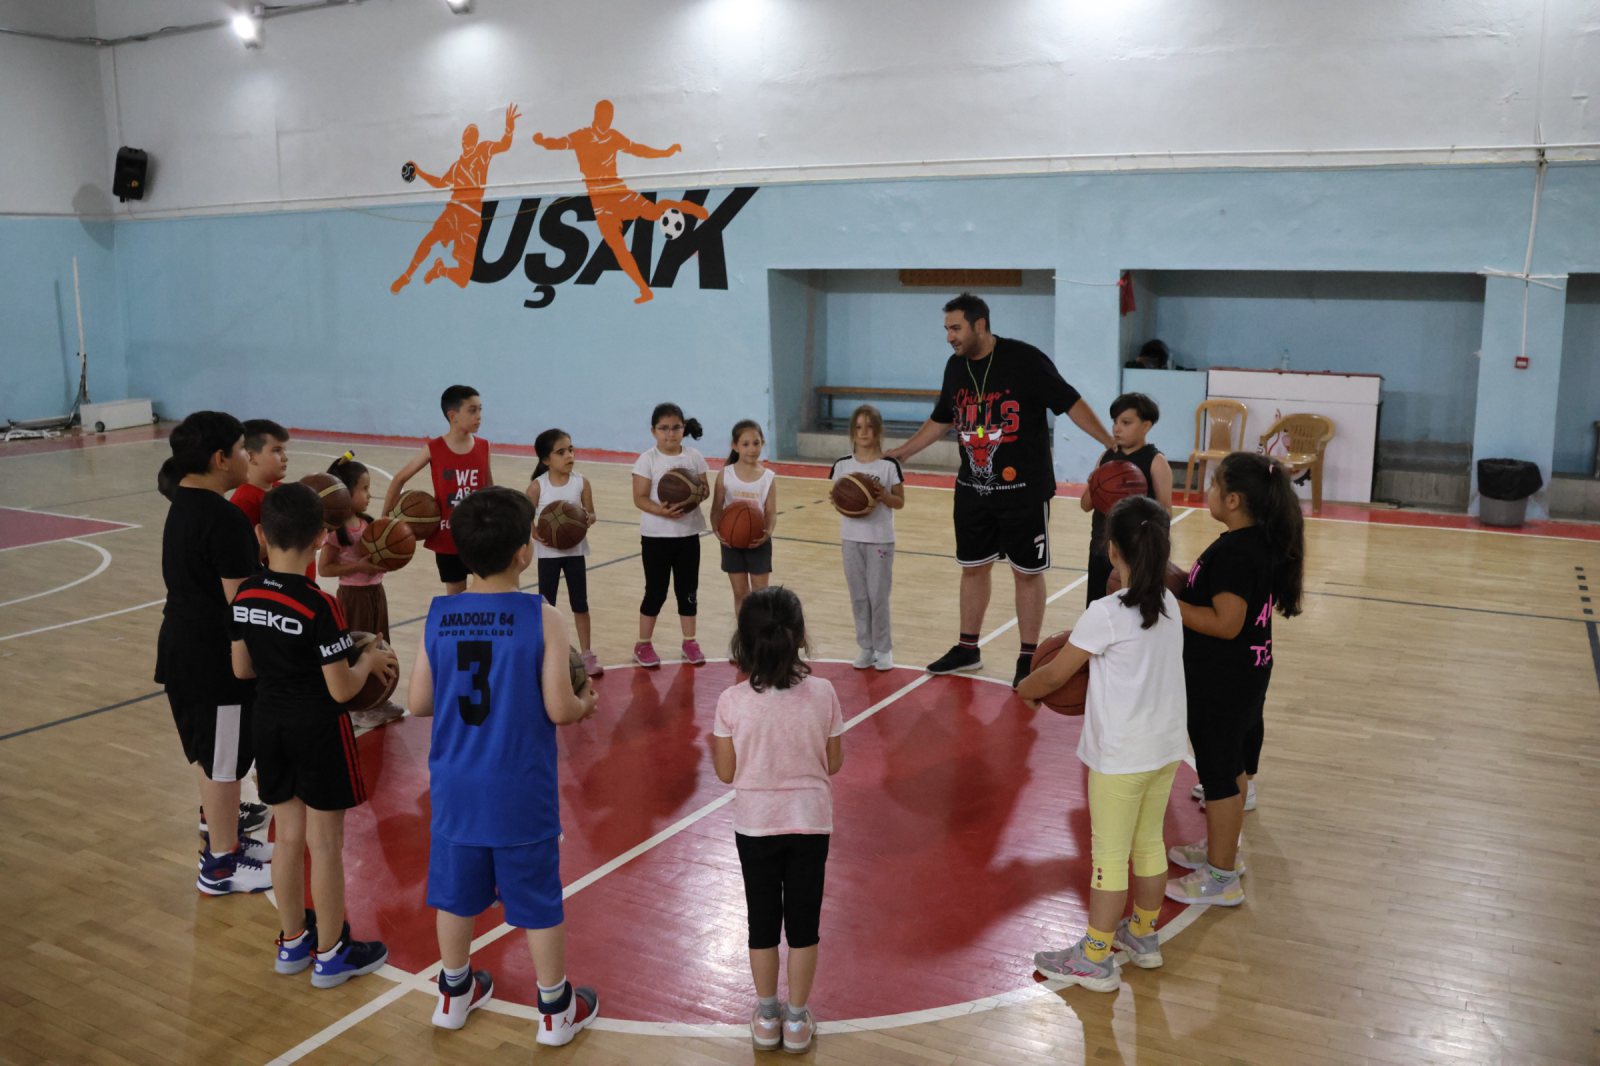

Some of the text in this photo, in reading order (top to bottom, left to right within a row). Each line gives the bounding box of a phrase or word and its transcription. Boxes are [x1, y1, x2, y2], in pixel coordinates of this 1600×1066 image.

[470, 187, 760, 308] UŞAK
[455, 469, 479, 487] WE
[455, 487, 476, 500] AR
[232, 605, 303, 635] BEKO
[440, 612, 515, 628] ANADOLU 64
[438, 629, 466, 637] SPOR
[457, 641, 493, 727] 3
